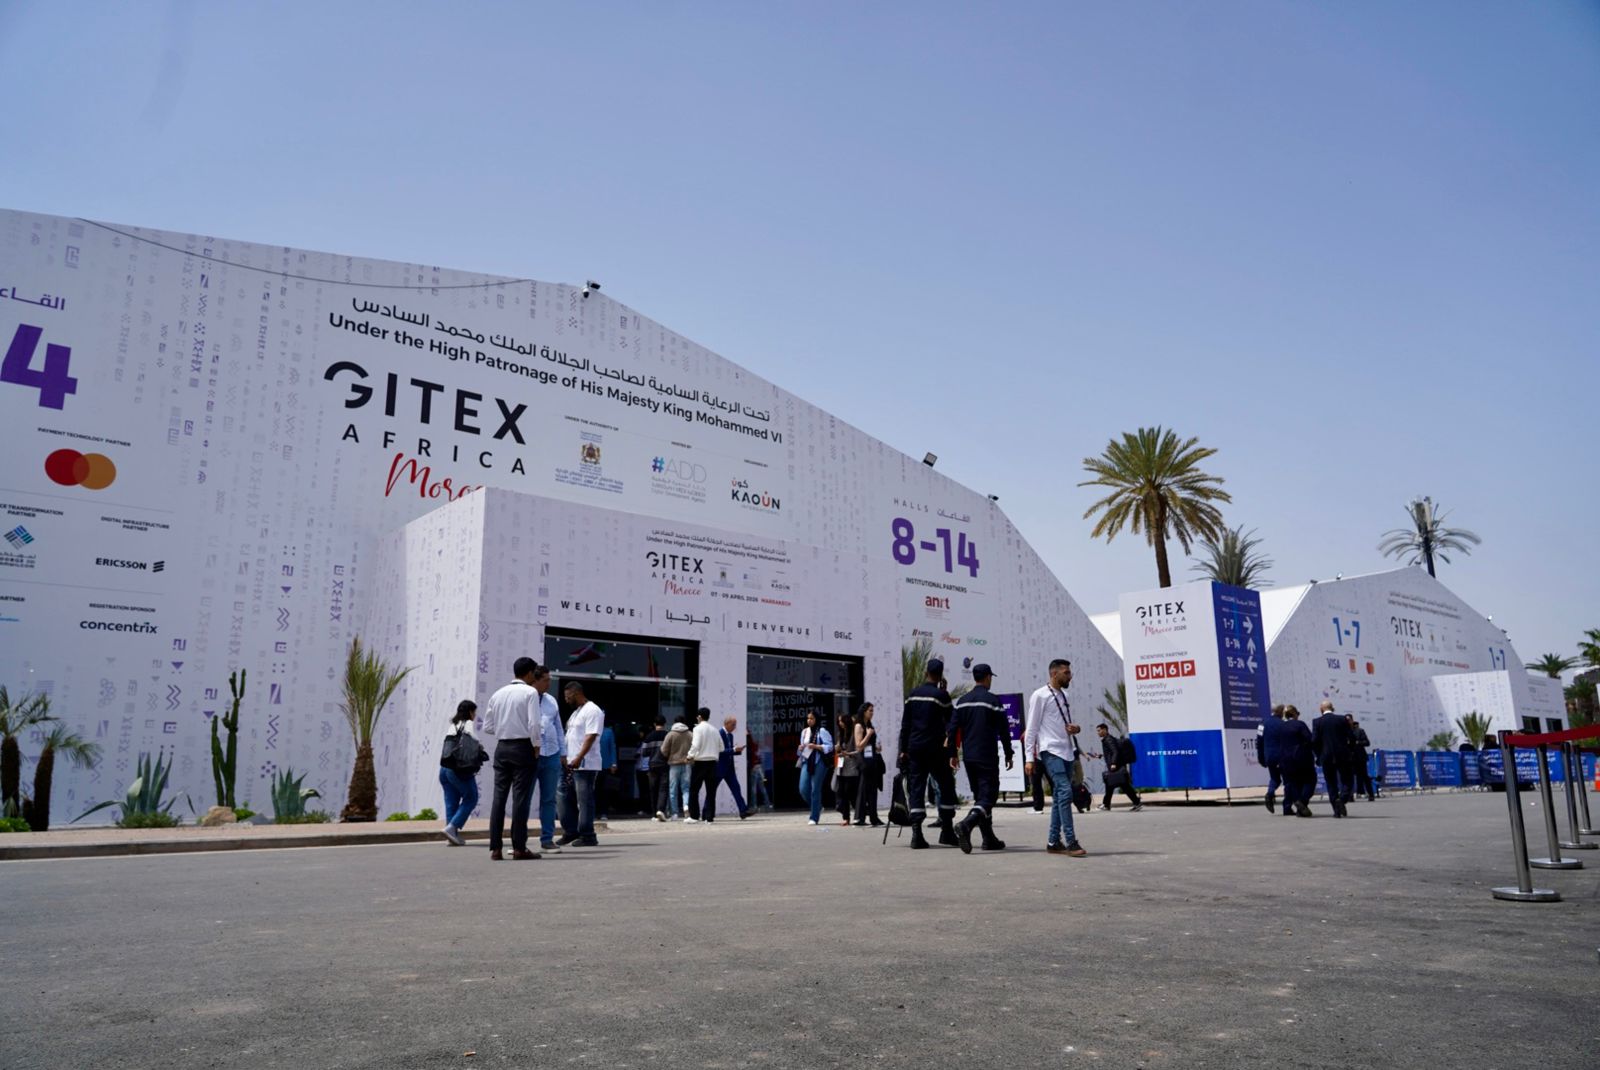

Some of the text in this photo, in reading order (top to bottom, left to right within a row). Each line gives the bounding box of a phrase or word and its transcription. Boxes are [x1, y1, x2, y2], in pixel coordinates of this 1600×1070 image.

[0, 286, 65, 310] القاع
[352, 297, 770, 422] تحت الرعاية السامية لصاحب الجلالة الملك محمد السادس
[329, 312, 783, 444] Under the High Patronage of His Majesty King Mohammed VI
[324, 360, 526, 445] GITEX
[37, 427, 132, 448] PAYMENT TECHNOLOGY PARTNER
[342, 424, 526, 476] AFRICA
[652, 456, 707, 484] #ADD
[8, 504, 64, 516] TRANSFORMATION
[894, 497, 928, 512] HALLS
[7, 510, 36, 518] PARTNER
[101, 516, 170, 530] DIGITAL INFRASTRUCTURE
[892, 517, 980, 578] 8-14
[95, 557, 148, 570] ERICSSON
[646, 551, 703, 574] GITEX
[652, 572, 704, 584] AFRICA
[906, 577, 967, 593] INSTITUTIONAL PARTNERS
[664, 580, 702, 595] Morocco
[89, 602, 129, 611] REGISTRATION
[560, 600, 635, 617] WELCOME
[925, 596, 950, 609] anrt
[1136, 601, 1184, 618] GITEX
[666, 609, 710, 625] مرحبا
[1141, 616, 1186, 626] AFRICA
[79, 620, 158, 634] concentrix
[737, 620, 810, 636] BIENVENUE
[1332, 617, 1360, 649] 1-7
[1391, 616, 1423, 639] GITEX
[1326, 658, 1340, 669] VISA
[1489, 647, 1505, 670] 1-7
[1138, 662, 1192, 678] UM6P
[758, 693, 814, 706] CATALYSING
[1137, 689, 1175, 698] Mohammed
[1138, 698, 1174, 706] Polytechnic
[752, 722, 792, 734] CONOMY
[1241, 738, 1258, 750] GITE
